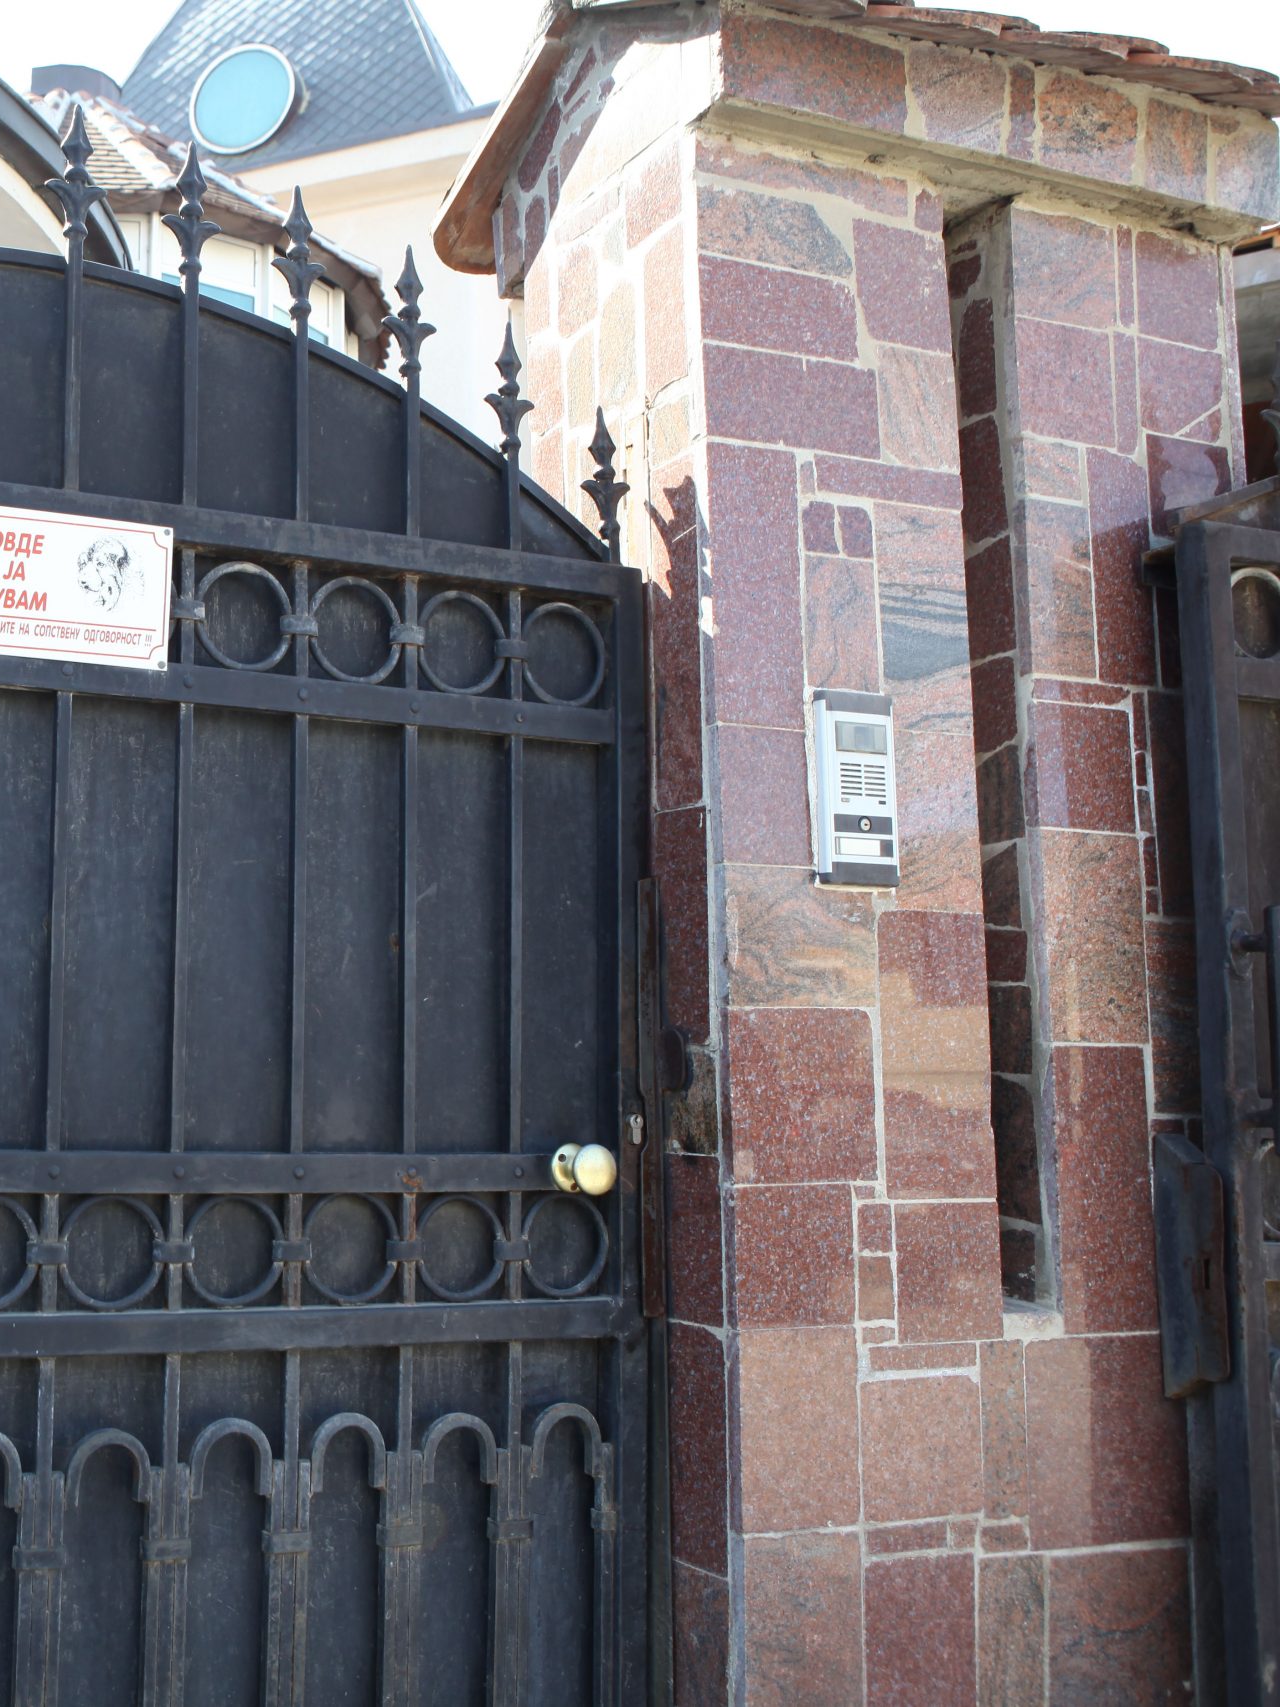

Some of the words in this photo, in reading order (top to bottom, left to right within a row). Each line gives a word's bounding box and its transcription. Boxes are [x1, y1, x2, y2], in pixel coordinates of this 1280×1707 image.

[3, 561, 26, 581] ЈА
[18, 622, 30, 636] НА
[34, 624, 81, 640] СОПСТВЕНУ
[83, 629, 142, 647] ОДГОВОРНОСТ
